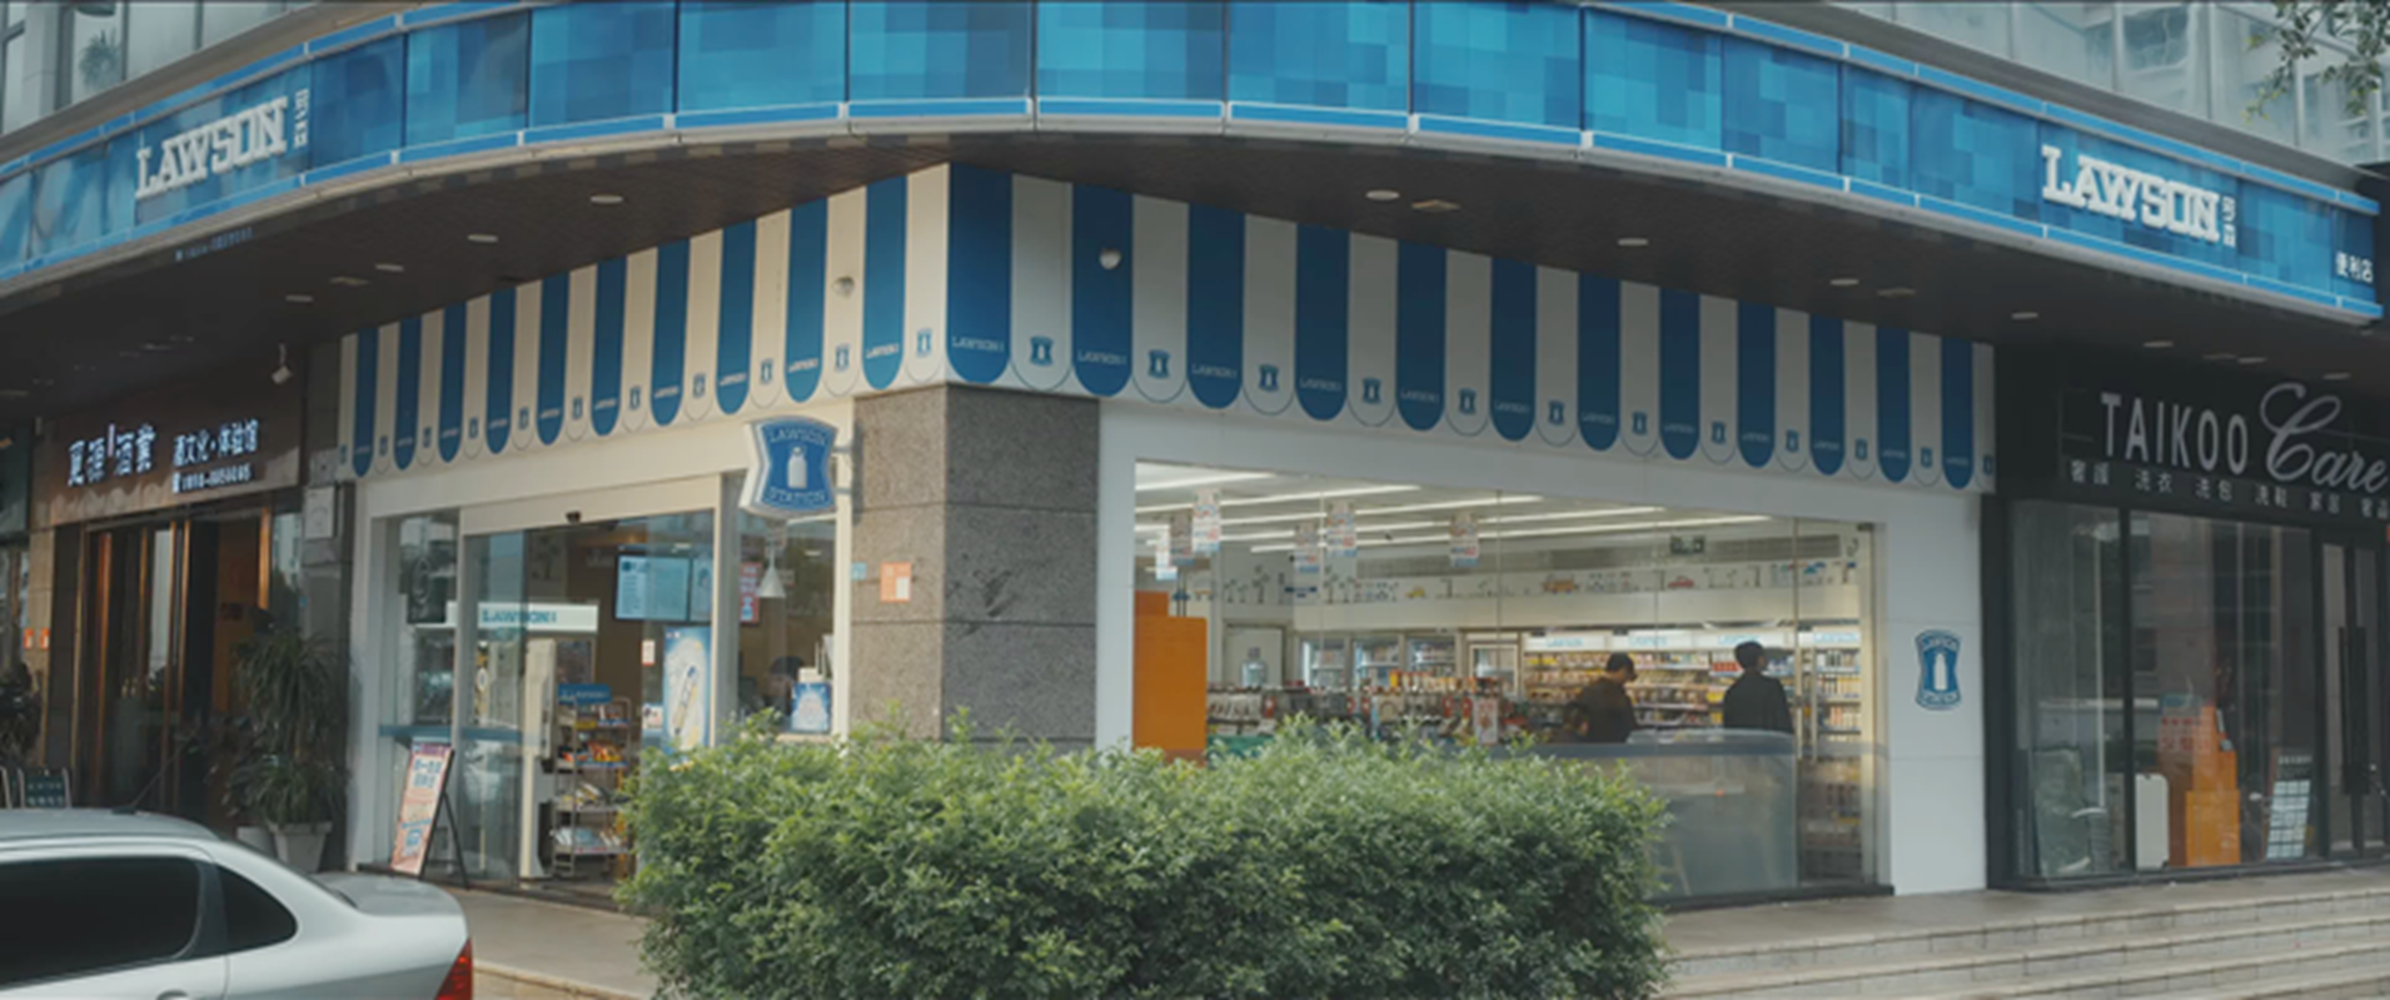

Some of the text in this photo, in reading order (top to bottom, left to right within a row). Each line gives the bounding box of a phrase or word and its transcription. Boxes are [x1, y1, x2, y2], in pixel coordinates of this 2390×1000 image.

[136, 97, 288, 198] LAWSON
[2042, 144, 2220, 244] LAWSON
[2335, 251, 2373, 284] 便利店
[768, 426, 827, 446] LAWSON
[2100, 382, 2390, 494] TAIKOO Care
[768, 486, 827, 506] STATION
[2135, 468, 2173, 493] 洗衣
[2195, 477, 2232, 502] 洗包
[482, 608, 549, 624] LAWSON
